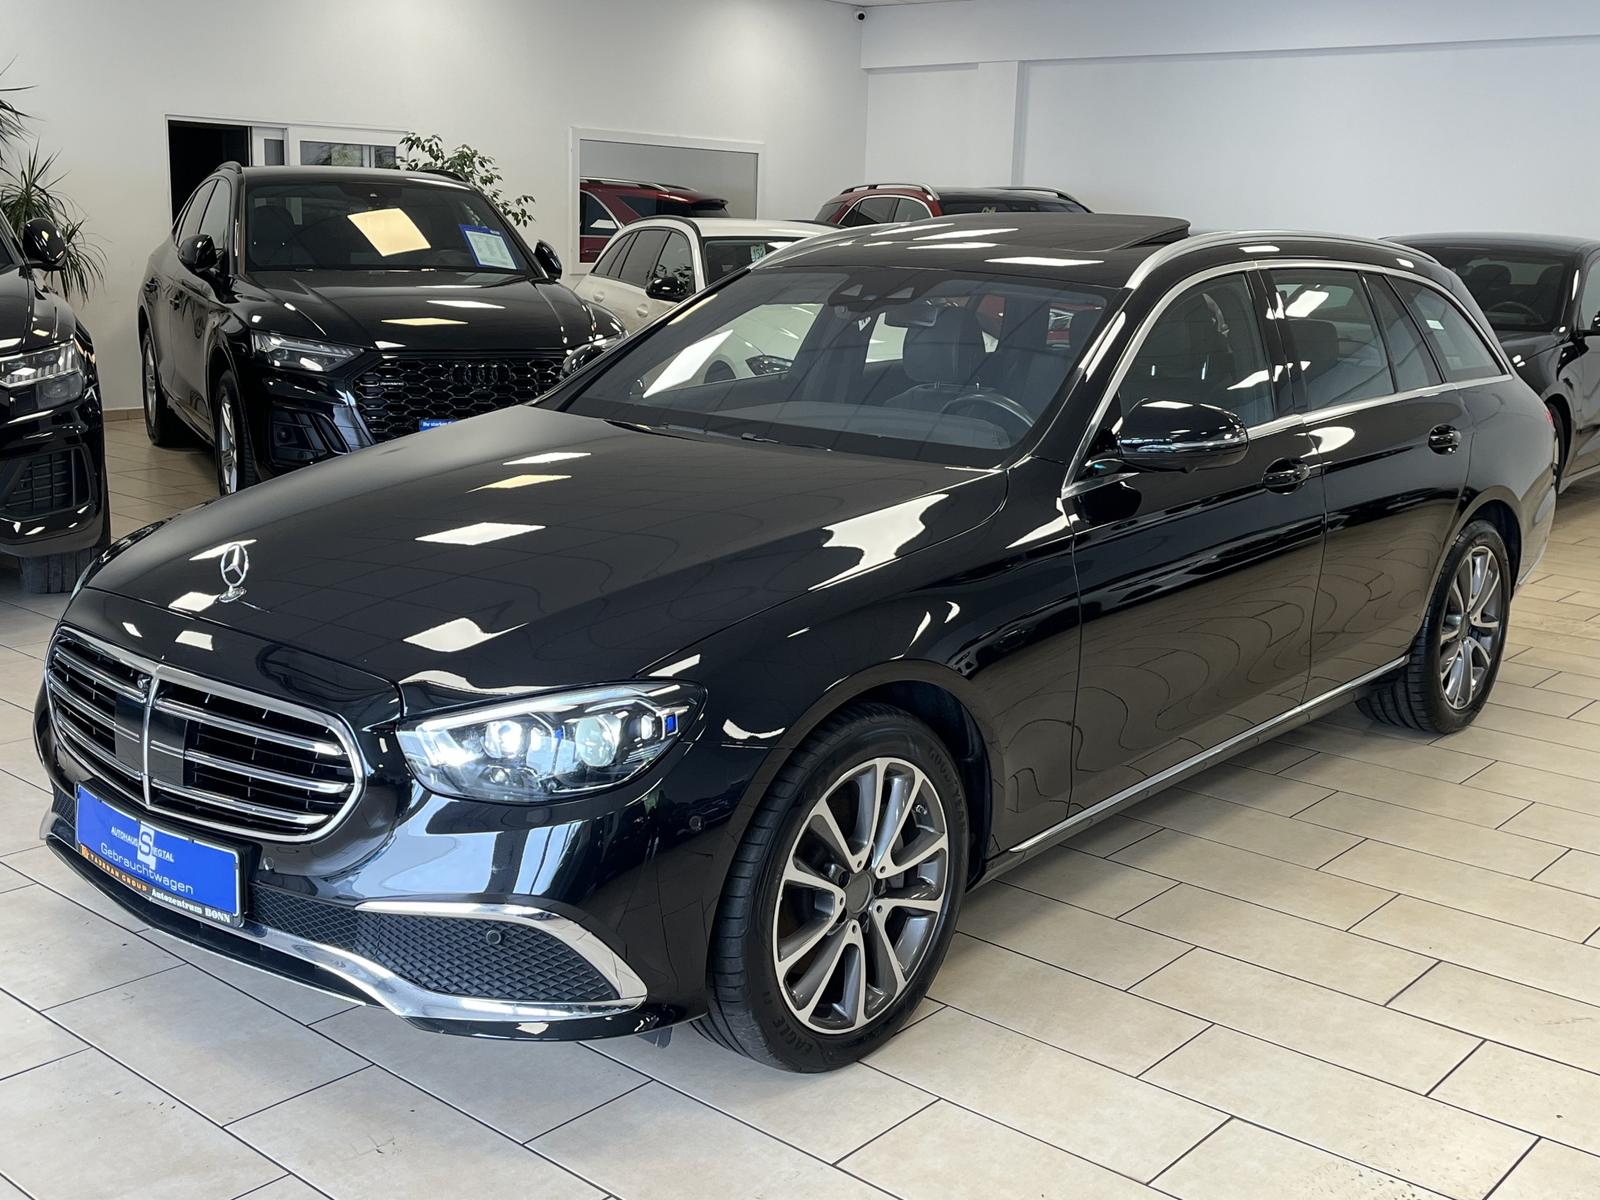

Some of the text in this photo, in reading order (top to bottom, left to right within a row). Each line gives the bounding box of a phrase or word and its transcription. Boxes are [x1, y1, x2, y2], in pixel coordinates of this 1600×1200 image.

[100, 842, 194, 895] Gebrauchtwagen
[121, 874, 148, 892] GROUP
[151, 888, 203, 914] Autozentrum
[204, 906, 231, 923] BONN
